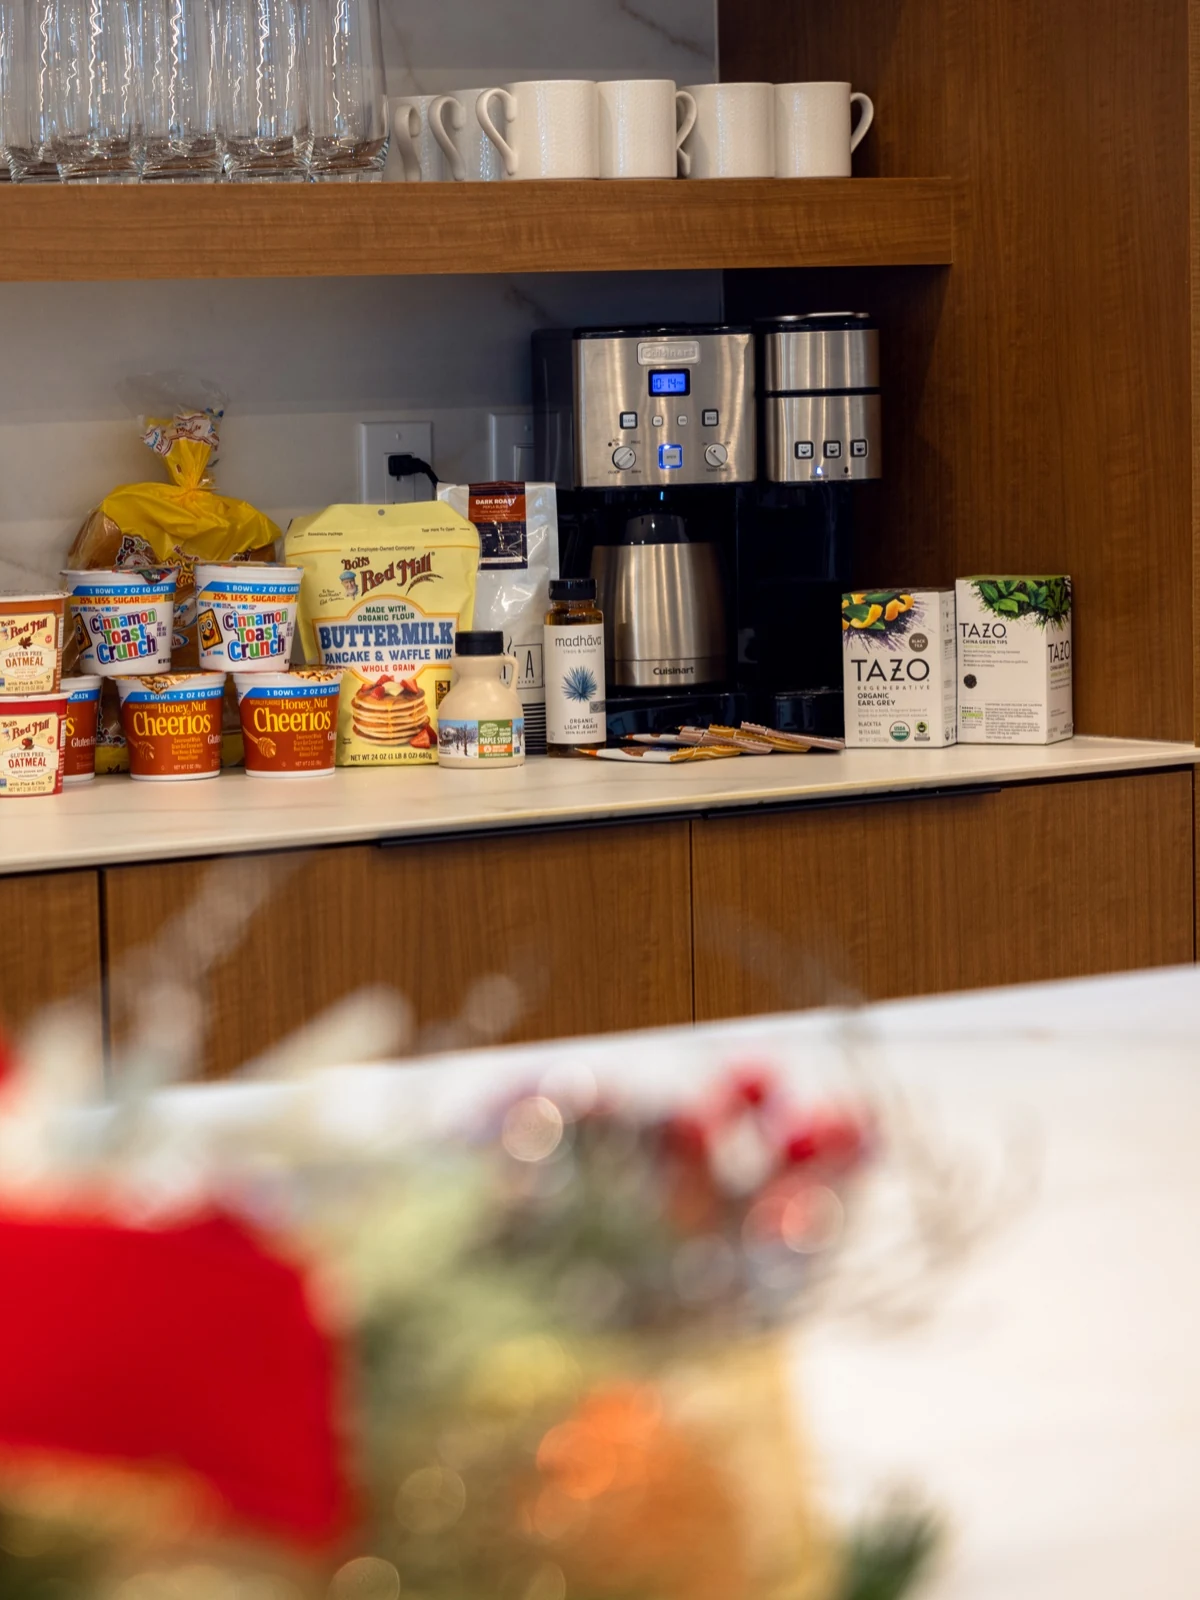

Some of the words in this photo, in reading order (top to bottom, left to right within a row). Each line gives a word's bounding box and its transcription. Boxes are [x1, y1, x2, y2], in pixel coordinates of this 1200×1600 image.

[653, 378, 677, 390] 10:14
[341, 556, 370, 570] Bob's
[360, 561, 396, 597] Red
[396, 552, 432, 587] Mill
[94, 596, 110, 604] LESS
[115, 596, 140, 604] SUGAR
[91, 609, 157, 631] Cinnamon
[224, 610, 288, 629] Cinnamon
[392, 612, 415, 620] FLOUR
[10, 622, 30, 640] Red
[30, 618, 48, 632] Mill
[104, 624, 147, 646] Toast
[237, 624, 278, 643] Toast
[318, 622, 454, 650] BUTTERMILK
[959, 623, 1006, 638] TAZO
[98, 634, 157, 662] Crunch
[230, 635, 285, 660] Crunch
[555, 635, 602, 648] madhāva
[325, 651, 373, 664] PANCAKE
[374, 650, 384, 661] &
[390, 650, 430, 660] WAFFLE
[435, 648, 452, 660] MIX
[1048, 640, 1070, 663] TAZO
[5, 656, 44, 668] OATMEAL
[362, 664, 389, 672] WHOLE
[392, 664, 416, 672] GRAIN
[851, 658, 930, 682] TAZO
[652, 666, 694, 676] Cuisinart
[206, 690, 222, 698] GRAIN
[158, 703, 188, 715] Honey
[191, 701, 206, 712] Nut
[280, 698, 311, 712] Honey
[314, 698, 328, 709] Nut
[133, 711, 211, 736] Cheerios
[254, 707, 331, 732] Cheerios
[12, 723, 31, 740] Red
[32, 718, 50, 735] Mill
[71, 738, 89, 748] Gluten
[8, 757, 46, 768] OATMEAL
